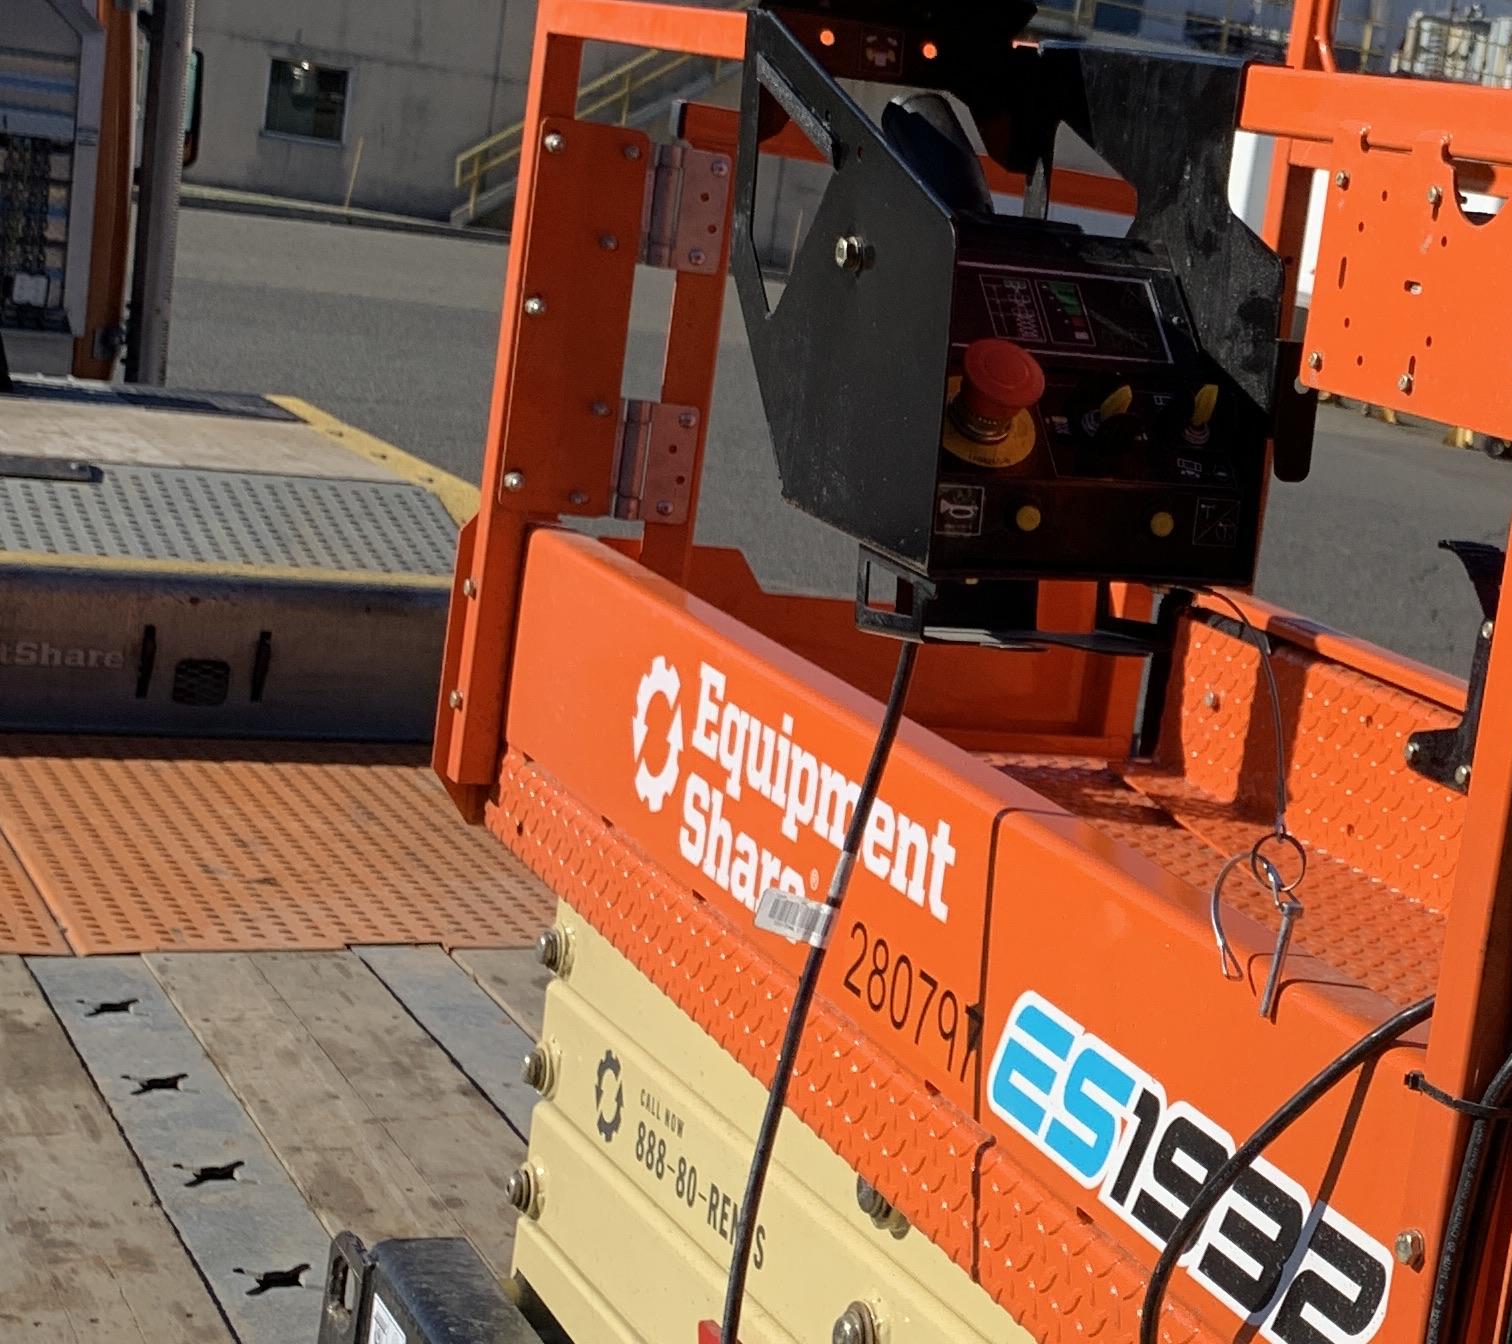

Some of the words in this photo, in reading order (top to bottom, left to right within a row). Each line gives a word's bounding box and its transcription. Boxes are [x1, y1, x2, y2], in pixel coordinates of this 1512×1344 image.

[692, 660, 956, 924] Equipment
[639, 1088, 661, 1122] CALL
[664, 1108, 685, 1139] NOW
[635, 1120, 767, 1271] 888-80-RENS
